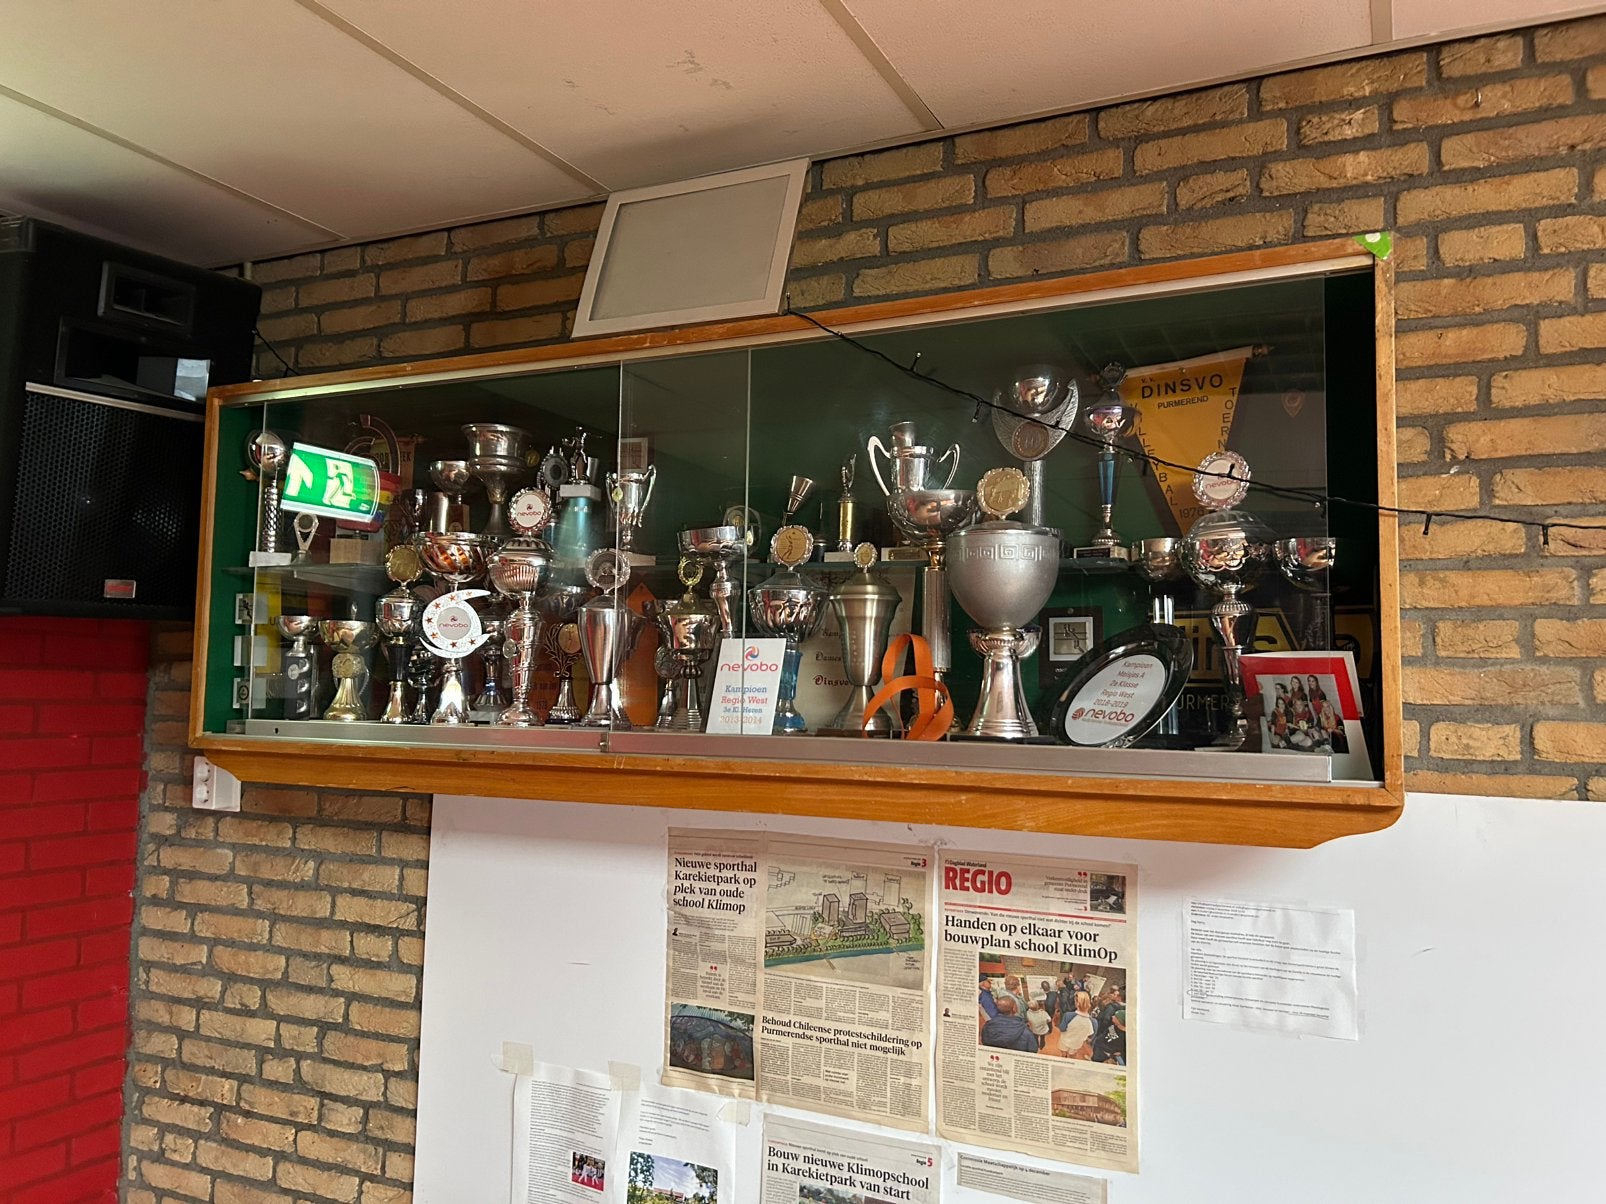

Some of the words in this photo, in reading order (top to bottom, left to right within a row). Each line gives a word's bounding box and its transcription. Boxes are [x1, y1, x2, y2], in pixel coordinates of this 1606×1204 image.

[1142, 374, 1223, 399] DINSVO
[1158, 396, 1208, 410] PURMEREND
[720, 661, 779, 672] nevobo
[725, 685, 768, 695] Kampioen
[813, 675, 850, 687] Dinsvo
[720, 696, 745, 706] Regio
[748, 696, 768, 704] West
[1084, 708, 1135, 722] nevobo
[675, 858, 712, 870] Nieuwe
[714, 860, 757, 872] sporthal
[674, 870, 740, 886] Karekietpark
[742, 877, 756, 888] op
[944, 866, 1012, 896] REGIO
[673, 883, 696, 895] plek
[698, 887, 716, 896] van
[719, 887, 744, 898] oude
[672, 896, 704, 908] school
[707, 899, 746, 914] Klimop
[945, 914, 999, 932] Handen
[1000, 924, 1017, 936] op
[1020, 922, 1063, 938] elkaar
[1067, 930, 1100, 942] voor
[944, 930, 1010, 952] bouwplan
[1014, 938, 1058, 954] school
[1063, 942, 1118, 964] KlimOp
[762, 1016, 792, 1028] Behoud
[793, 1021, 832, 1034] Chileense
[834, 1027, 910, 1048] protestschildering
[911, 1040, 922, 1050] op
[762, 1026, 814, 1041] Purmerendse
[816, 1034, 849, 1046] sporthal
[851, 1040, 868, 1050] niet
[870, 1043, 906, 1056] mogelijk
[768, 1145, 800, 1162] Bouw
[803, 1152, 844, 1171] nieuwe
[847, 1162, 929, 1190] Klimopschool
[927, 1157, 932, 1168] 5
[768, 1159, 778, 1172] in
[782, 1164, 857, 1188] Karekietpark
[860, 1181, 880, 1194] van
[883, 1185, 910, 1200] start
